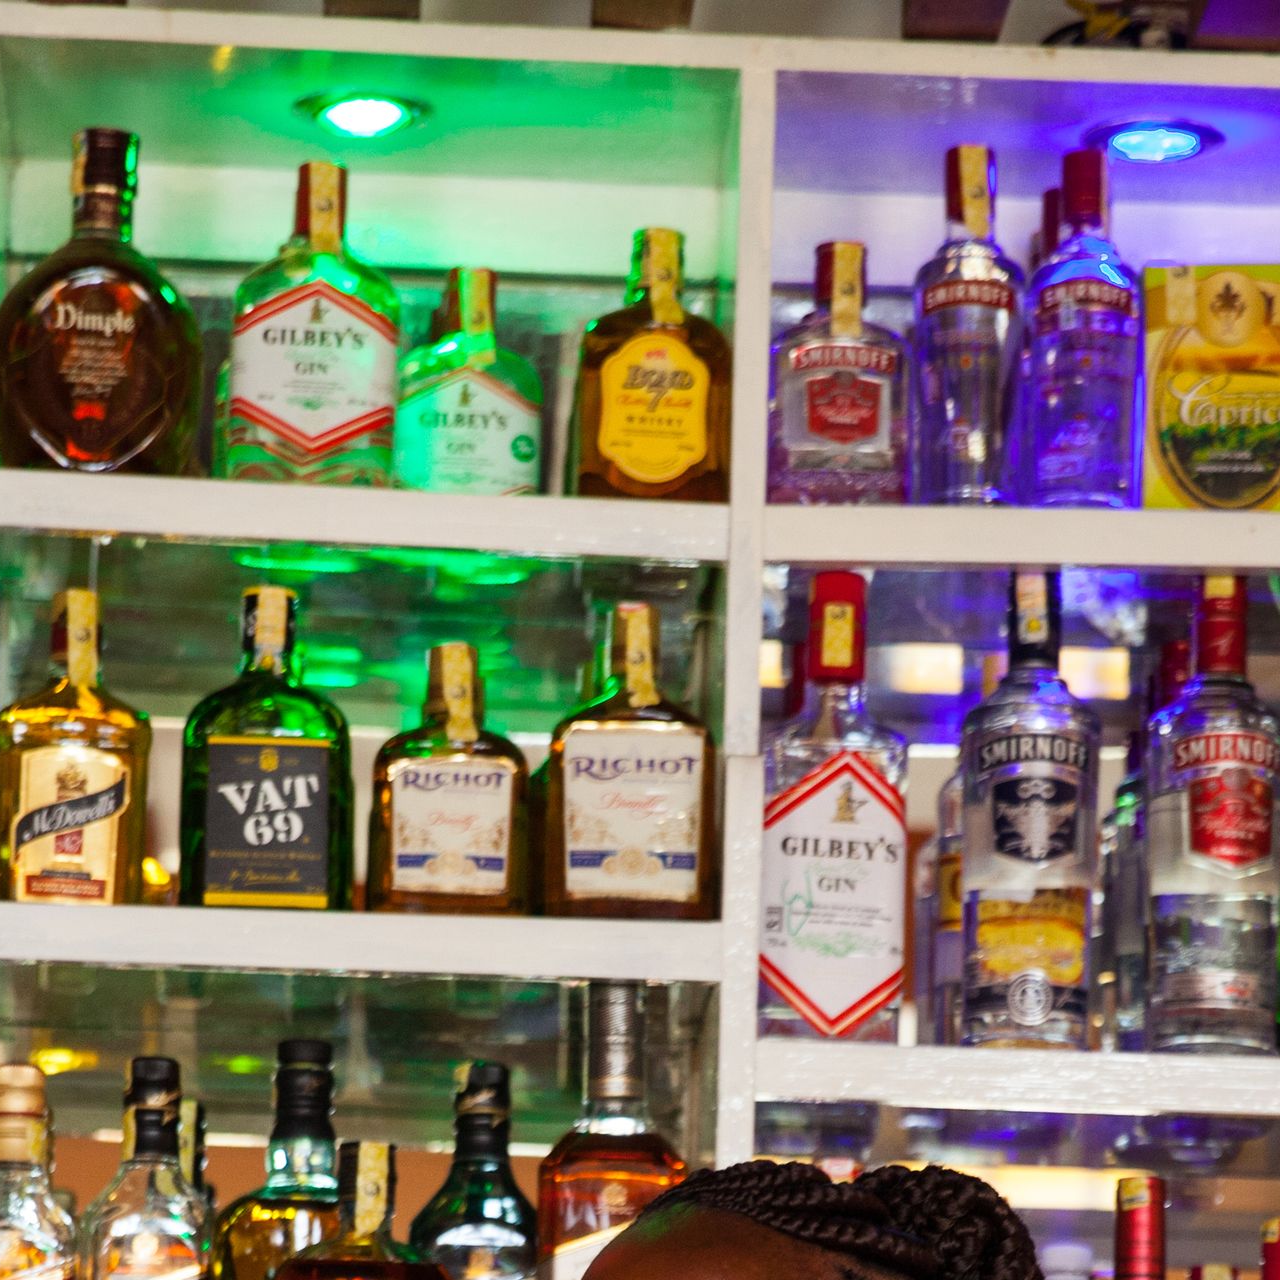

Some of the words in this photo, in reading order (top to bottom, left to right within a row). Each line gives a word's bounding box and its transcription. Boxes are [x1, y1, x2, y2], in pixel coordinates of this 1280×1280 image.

[55, 302, 136, 337] Dimple
[262, 327, 366, 348] GILBEY'S
[401, 768, 507, 792] RICHOT
[571, 755, 701, 782] RICHOT
[218, 773, 320, 816] VAT
[243, 810, 305, 847] 69
[781, 836, 899, 863] GILBEY'S
[817, 876, 858, 893] GIN
